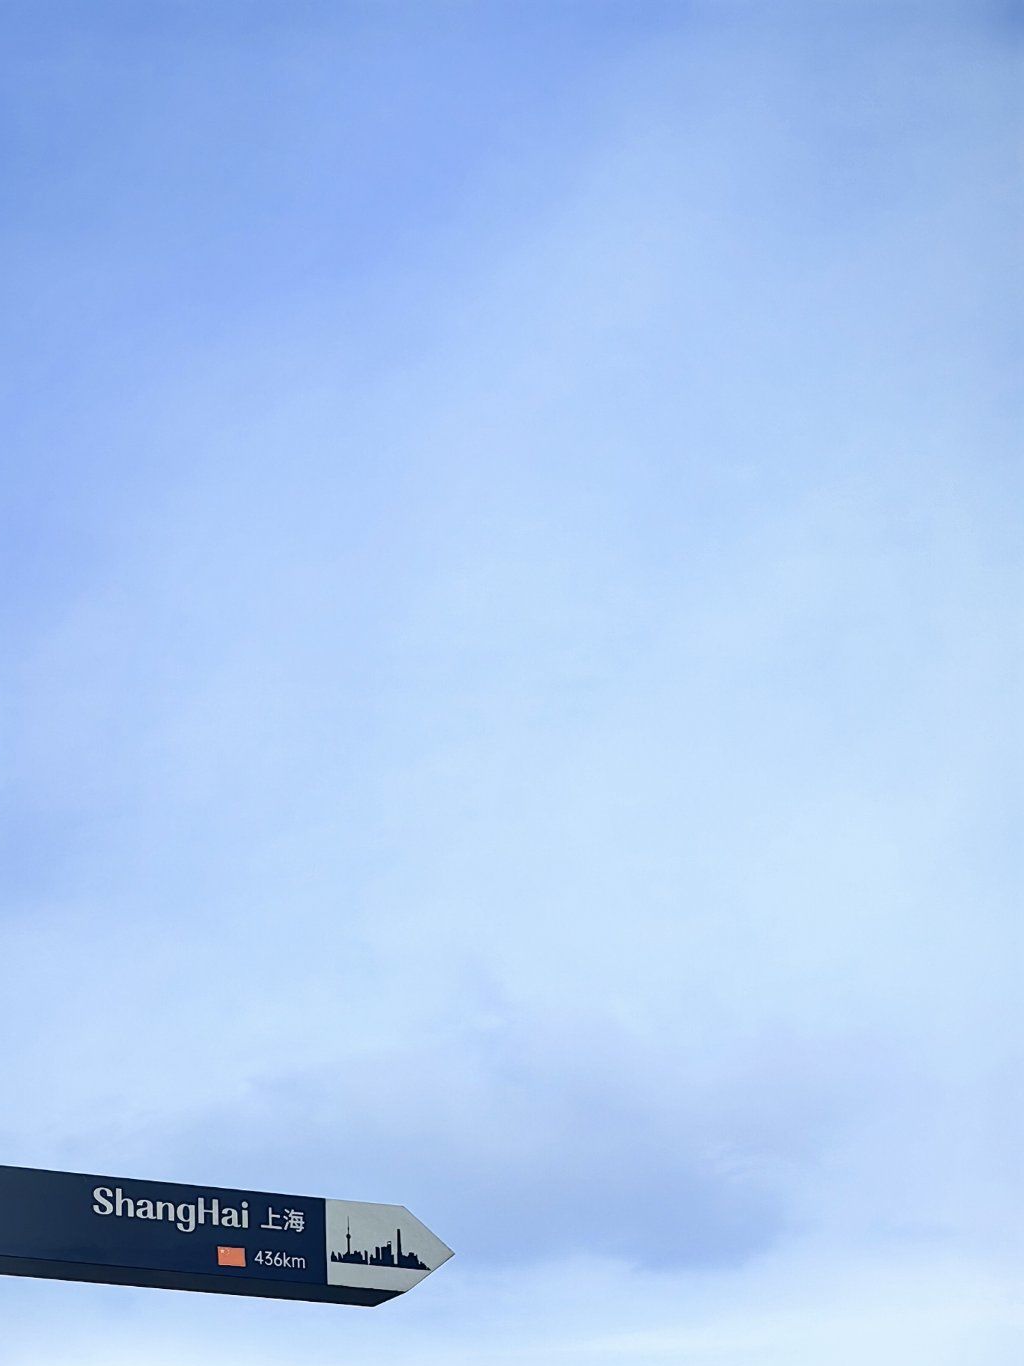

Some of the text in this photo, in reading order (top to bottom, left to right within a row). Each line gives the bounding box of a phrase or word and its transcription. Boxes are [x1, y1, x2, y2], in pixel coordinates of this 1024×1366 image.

[92, 1187, 305, 1232] ShangHai 上海
[254, 1250, 306, 1269] 436km
